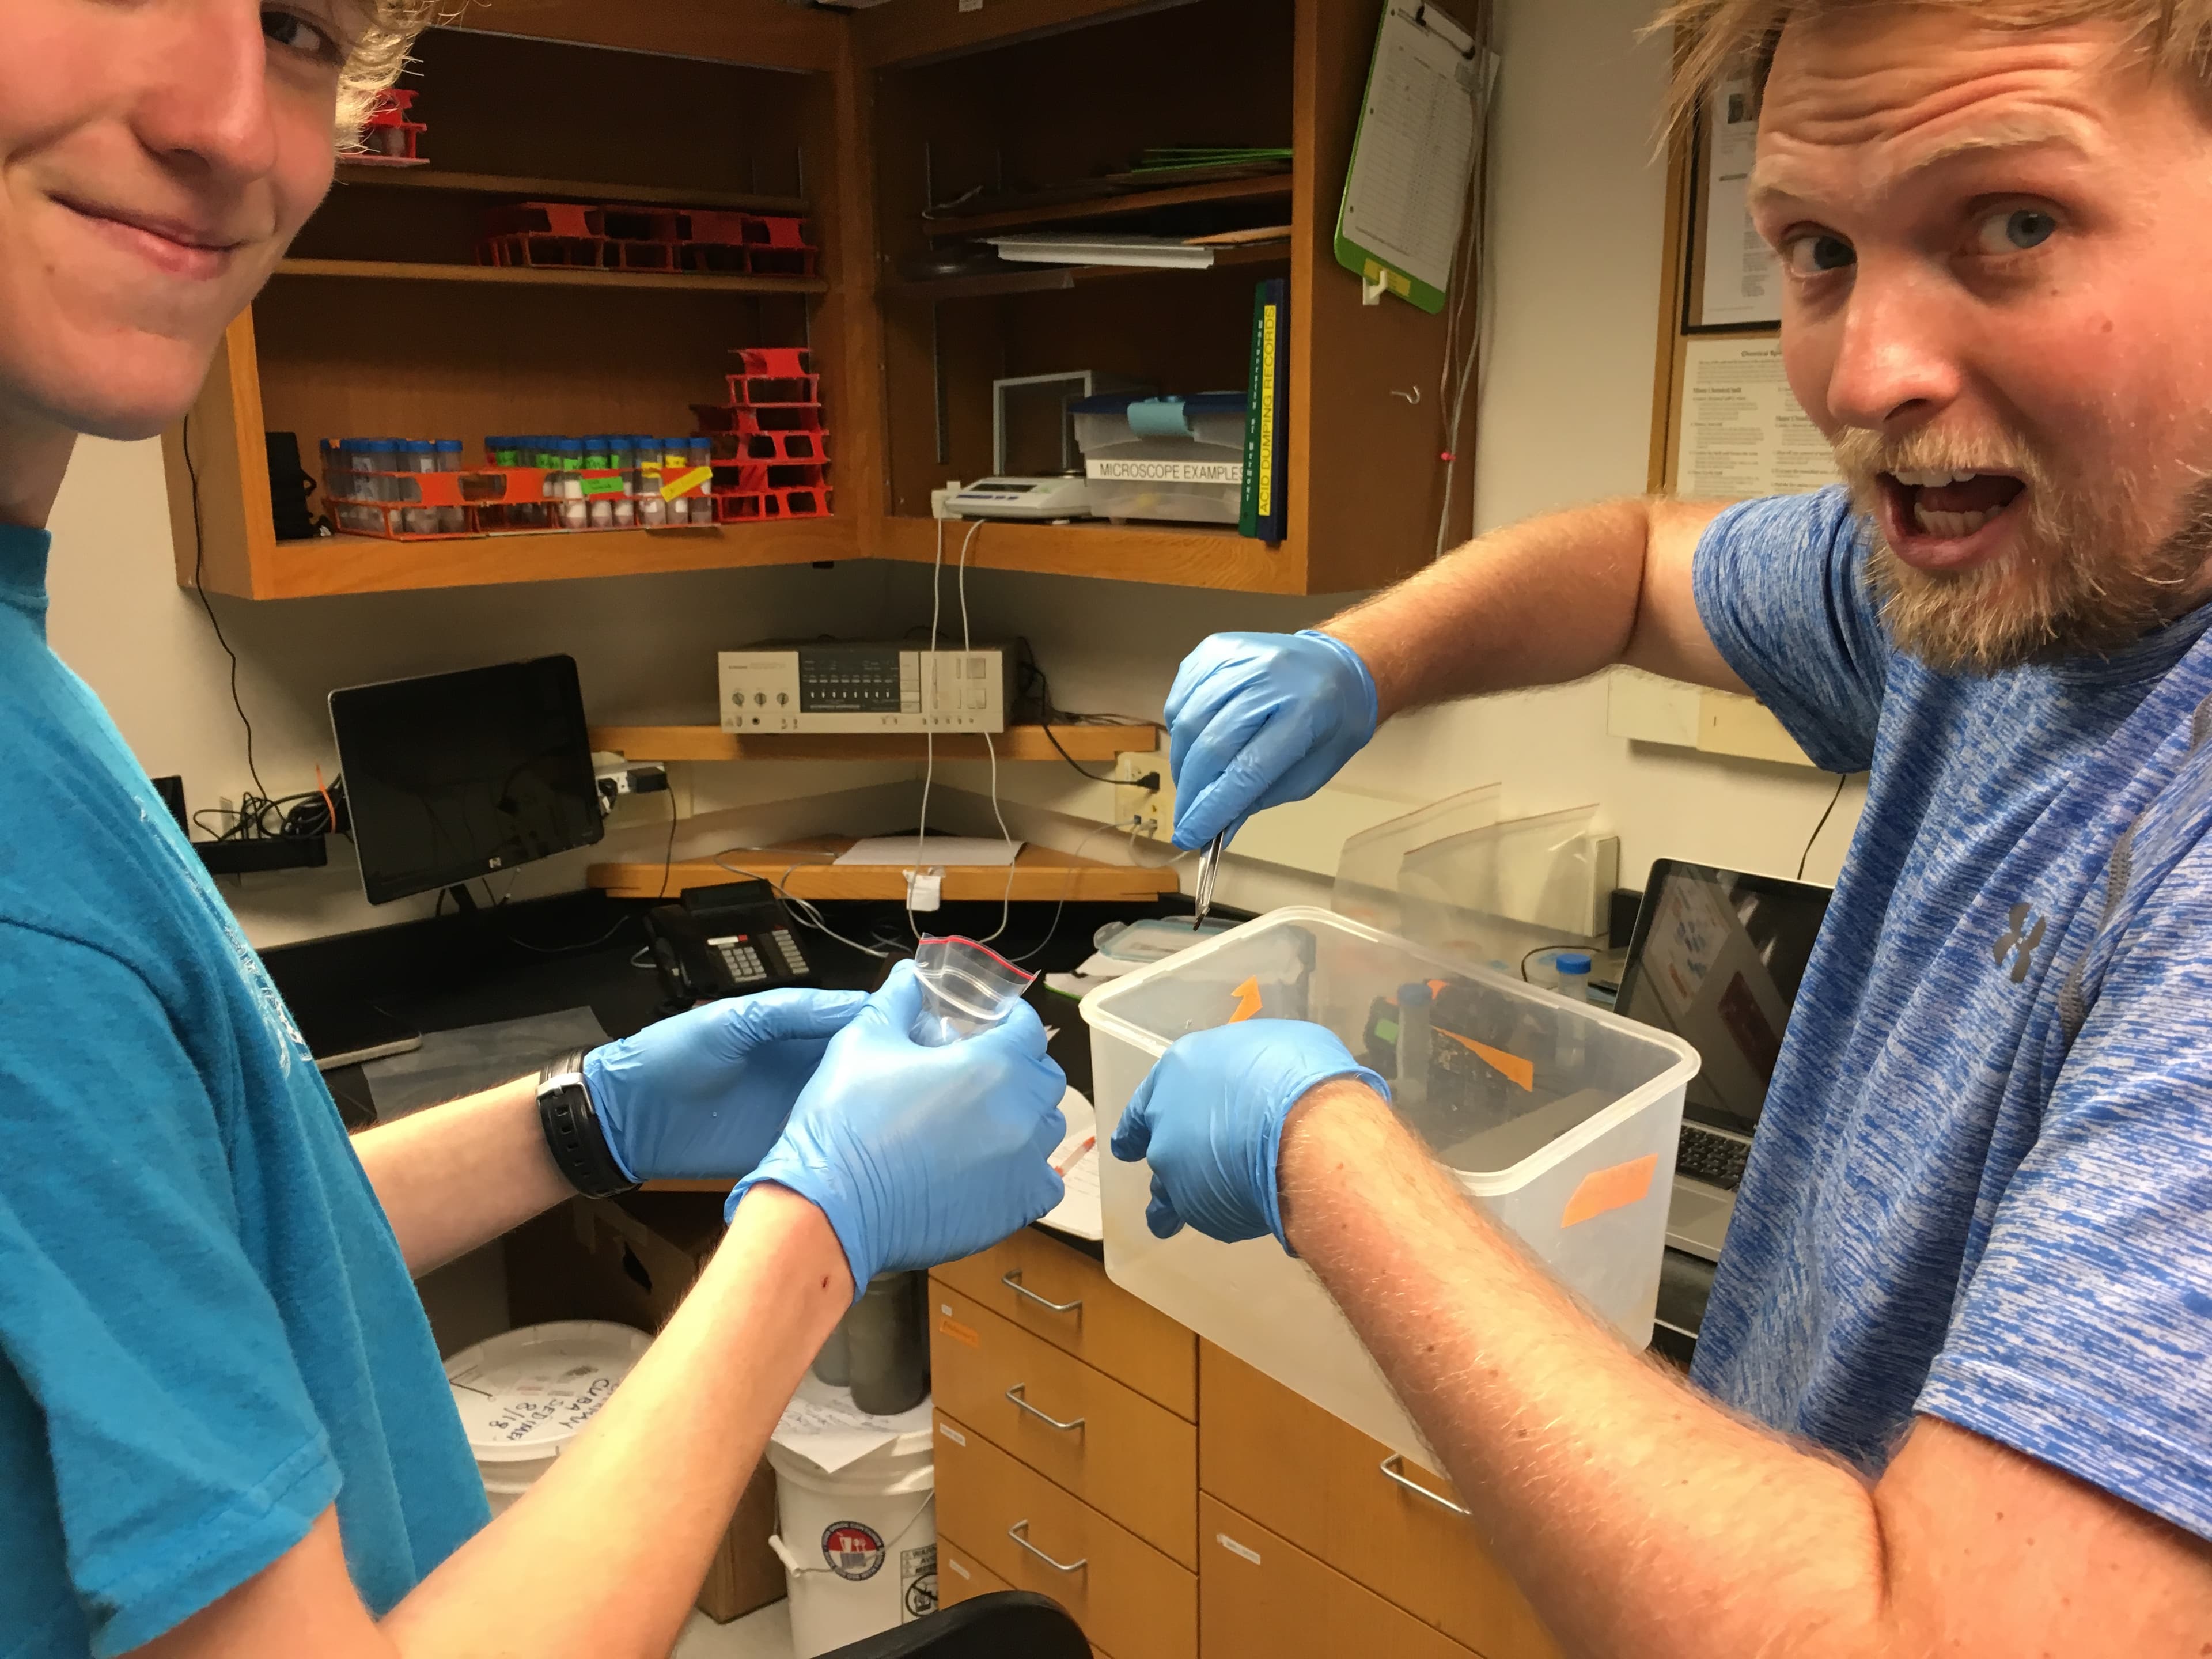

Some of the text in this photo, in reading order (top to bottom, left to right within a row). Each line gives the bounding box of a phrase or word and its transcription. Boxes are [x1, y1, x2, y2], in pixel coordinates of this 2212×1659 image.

[1259, 306, 1275, 513] ACID DUMPING RECORDS
[1100, 463, 1180, 479] MICROSCOPE
[565, 1378, 609, 1411] CUBA
[489, 1402, 537, 1429] 8/18
